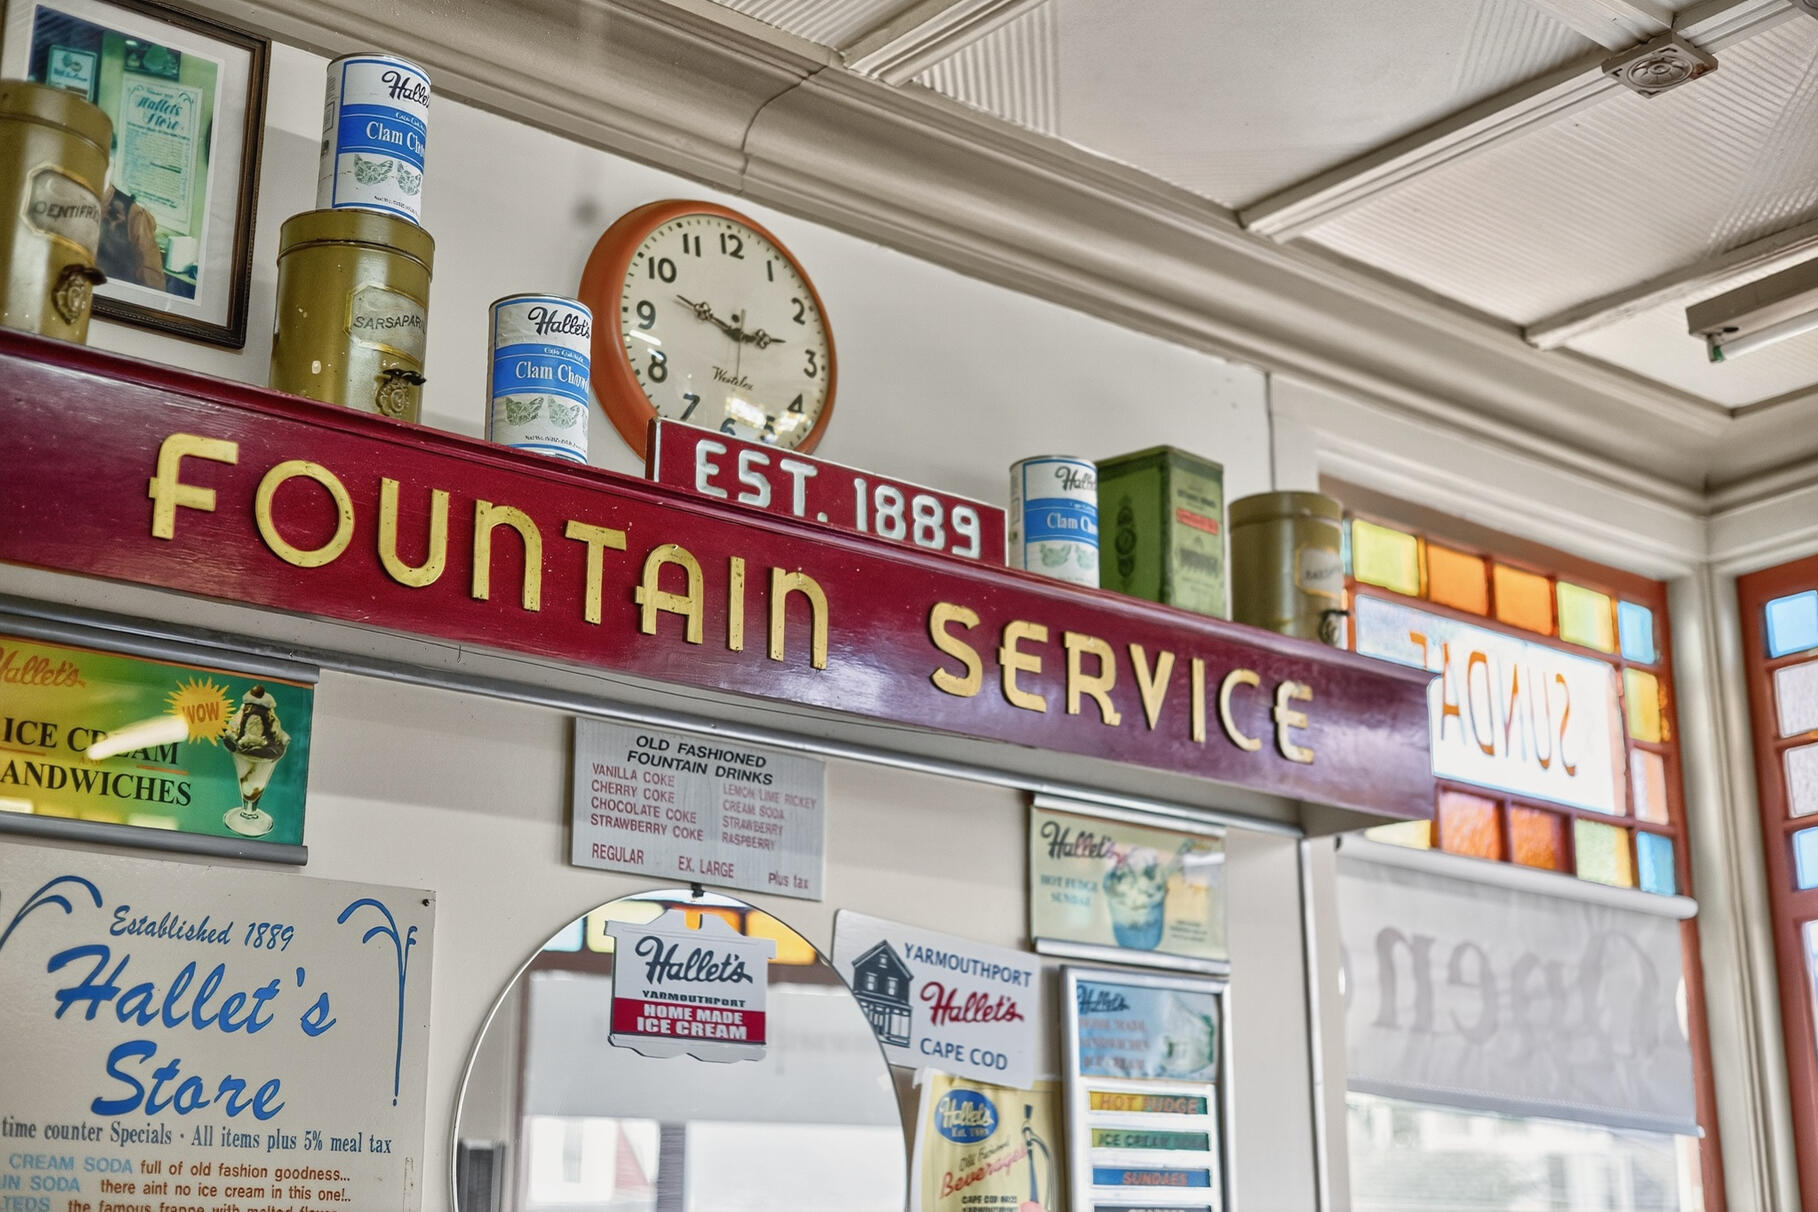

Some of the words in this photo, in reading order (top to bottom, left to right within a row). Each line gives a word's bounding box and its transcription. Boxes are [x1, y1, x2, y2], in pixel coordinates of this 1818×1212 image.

[366, 121, 403, 145] Clam
[682, 233, 702, 258] 11
[720, 233, 745, 260] 12
[648, 256, 677, 284] 10
[766, 260, 774, 282] 1
[528, 306, 591, 340] Hallet's
[636, 300, 656, 330] 9
[791, 297, 806, 325] 2
[515, 361, 553, 380] Clam
[647, 350, 668, 384] 8
[803, 349, 818, 379] 3
[680, 392, 701, 420] 7
[787, 393, 805, 414] 4
[695, 438, 828, 523] EST.
[853, 477, 981, 560] 1889
[1046, 511, 1079, 530] Clam
[148, 432, 829, 671] FOUNTAIN
[928, 601, 1315, 765] SERVICE
[182, 701, 221, 725] WOW
[3, 717, 58, 749] ICE
[635, 735, 670, 752] OLD
[677, 742, 767, 769] FASHIONED
[592, 762, 638, 782] VANILLA
[643, 771, 675, 788] COKE
[627, 750, 708, 775] FOUNTAIN
[714, 765, 774, 786] DRINKS
[591, 779, 638, 798] CHERRY
[643, 788, 675, 805] COKE
[722, 783, 756, 800] LEMON
[759, 788, 780, 804] LIME
[591, 796, 660, 819] CHOCOLATE
[665, 808, 697, 825] COKE
[722, 799, 756, 816] CREAM
[759, 804, 785, 820] SODA
[590, 813, 668, 837] STRAWBERRY
[672, 825, 704, 842] COKE
[721, 814, 784, 837] STRAWBERRY
[721, 831, 777, 852] RASPBERRY
[591, 842, 645, 865] REGULAR
[678, 855, 695, 874] EX.
[699, 859, 735, 879] LARGE
[793, 873, 809, 890] tax
[109, 904, 234, 946] Established
[244, 921, 294, 952] 1889
[634, 935, 753, 985] Hallet's
[903, 942, 1033, 988] YARMOUTHPORT
[47, 943, 337, 1037] Hallet's
[642, 989, 747, 1008] YARMOUTHPORT
[919, 981, 1025, 1027] Hallet's
[636, 1016, 672, 1034] ICE
[675, 1020, 747, 1040] CREAM
[643, 1003, 693, 1021] HOME
[696, 1007, 744, 1025] MADE
[919, 1037, 965, 1063] CAPE
[969, 1048, 1009, 1071] COD
[91, 1039, 286, 1121] Store
[1143, 1096, 1198, 1115] FUDGE
[1, 1115, 38, 1139] time
[44, 1120, 104, 1142] counter
[110, 1120, 173, 1148] Specials
[191, 1124, 214, 1147] All
[221, 1125, 261, 1149] items
[266, 1128, 298, 1153] plus
[304, 1129, 324, 1151] 5%
[330, 1131, 363, 1153] meal
[369, 1134, 392, 1154] tax
[8, 1152, 75, 1171] CREAM
[84, 1156, 133, 1175] SODA
[140, 1159, 162, 1175] full
[168, 1160, 184, 1176] of
[190, 1161, 212, 1177] old
[218, 1162, 268, 1179] fashion
[274, 1166, 351, 1183] goodness...
[30, 1175, 81, 1193] SODA
[100, 1179, 136, 1195] there
[142, 1180, 168, 1196] aint
[175, 1184, 192, 1197] no
[197, 1181, 218, 1198] ice
[224, 1184, 265, 1200] cream
[271, 1184, 282, 1200] in
[288, 1185, 312, 1201] this
[67, 1199, 92, 1212] the
[98, 1200, 152, 1212] famous
